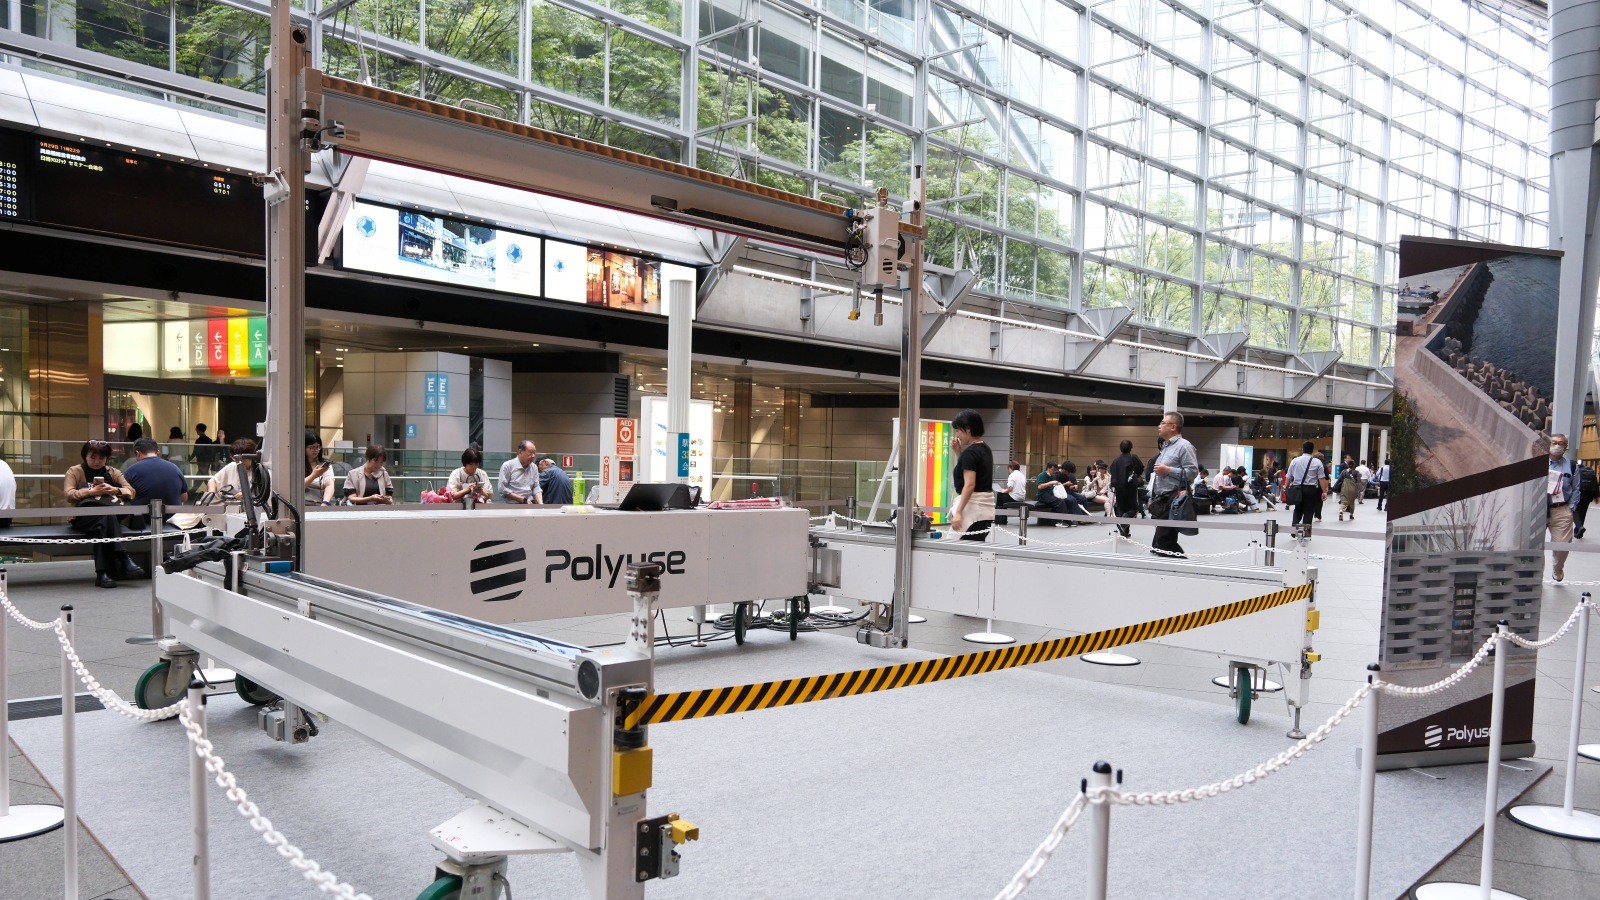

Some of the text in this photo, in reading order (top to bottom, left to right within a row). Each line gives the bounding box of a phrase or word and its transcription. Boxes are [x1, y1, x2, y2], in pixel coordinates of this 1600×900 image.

[195, 349, 203, 360] D
[214, 349, 222, 360] C
[255, 348, 262, 359] A
[428, 382, 434, 391] E
[440, 382, 446, 392] E
[922, 435, 927, 445] D
[929, 436, 934, 445] C
[943, 436, 948, 445] A
